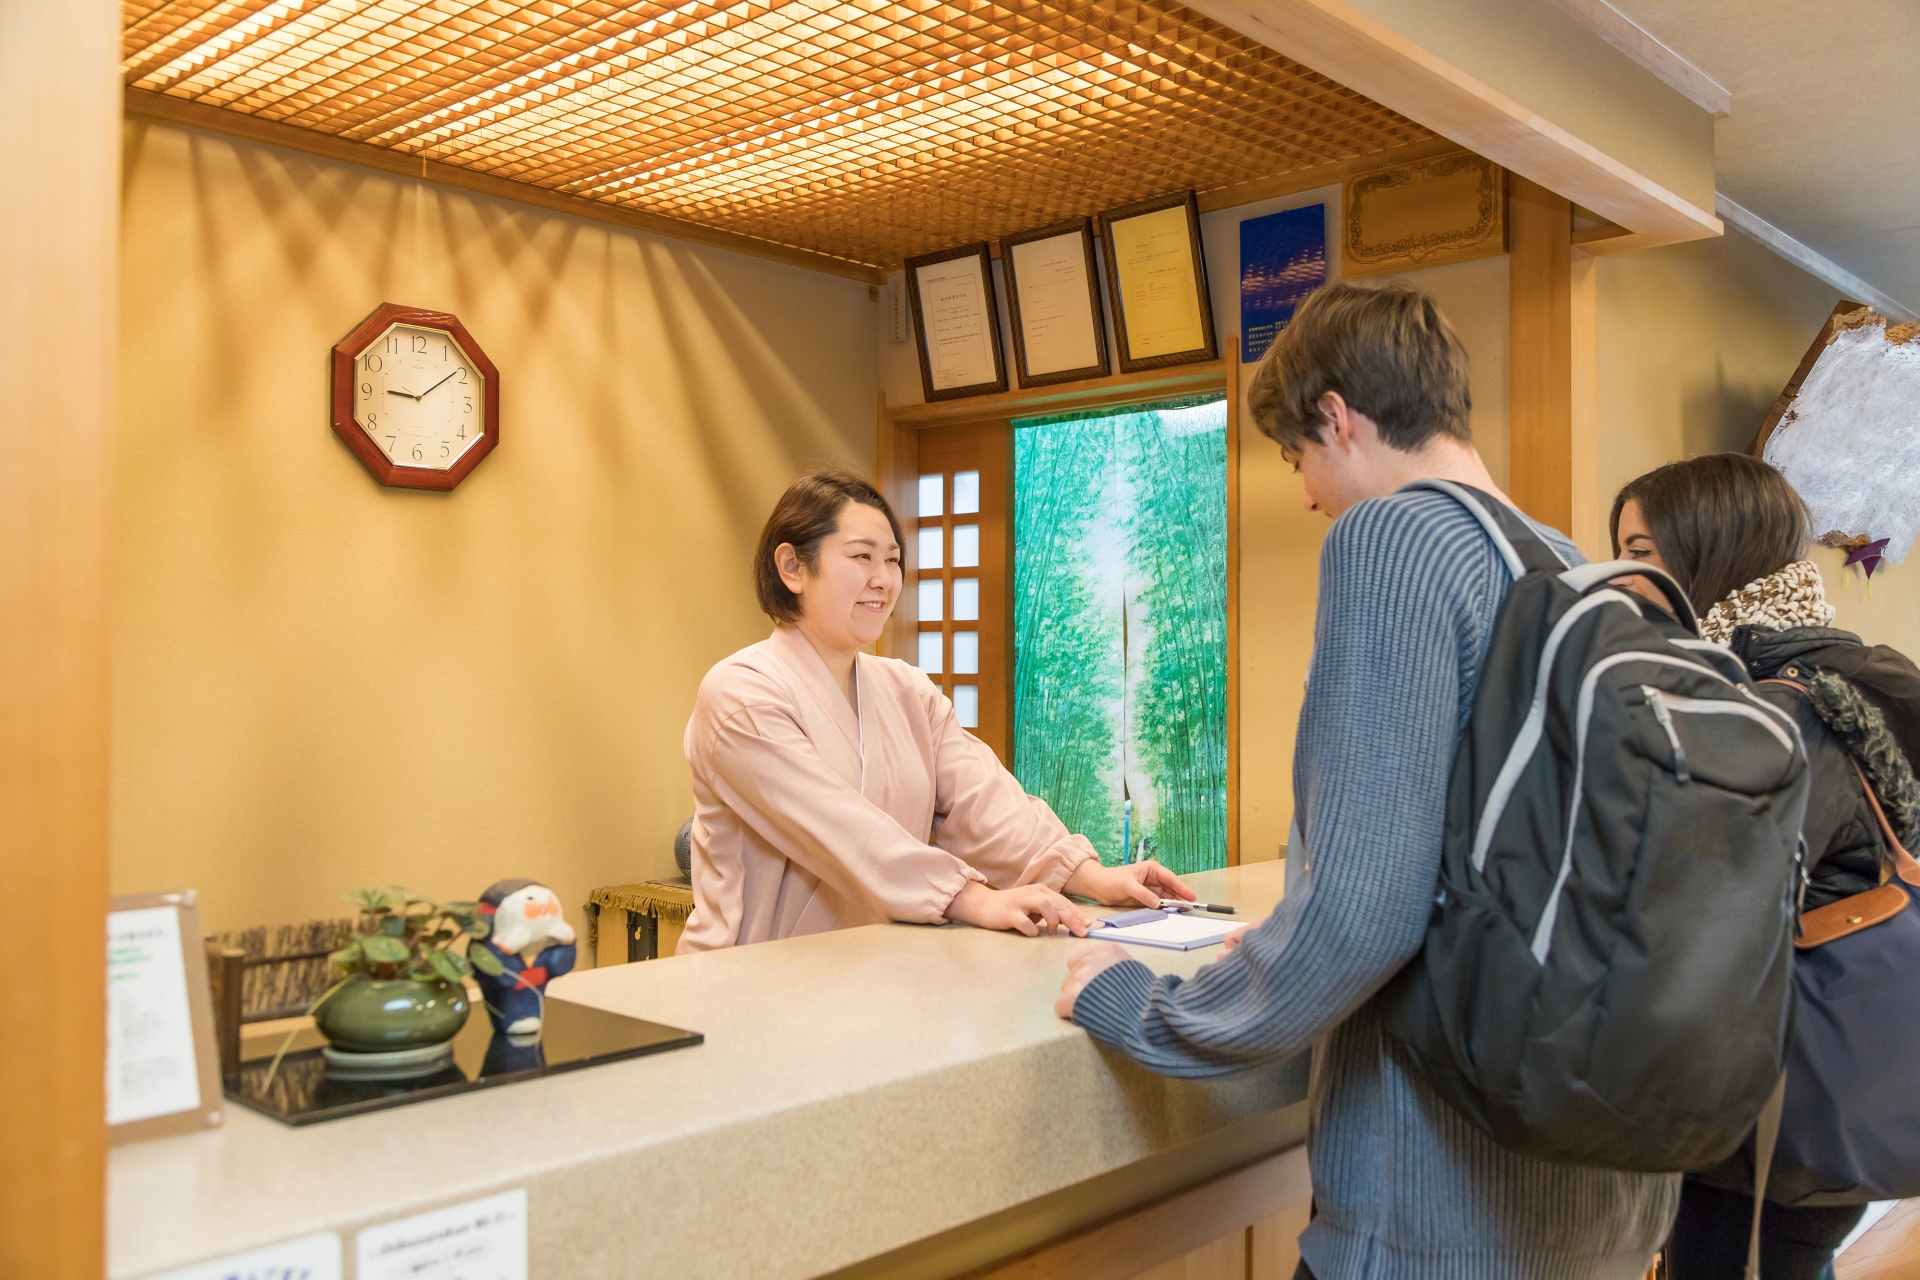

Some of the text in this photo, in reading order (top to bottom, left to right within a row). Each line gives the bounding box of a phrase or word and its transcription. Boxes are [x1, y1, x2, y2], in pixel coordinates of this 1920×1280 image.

[386, 336, 398, 354] 11
[411, 335, 427, 354] 12
[443, 345, 447, 361] 1
[364, 353, 383, 372] 10
[457, 367, 468, 384] 2
[361, 383, 373, 400] 9
[463, 396, 473, 413] 3
[367, 413, 377, 430] 8
[456, 424, 467, 440] 4
[386, 435, 396, 452] 7
[412, 443, 423, 461] 6
[440, 441, 450, 458] 5
